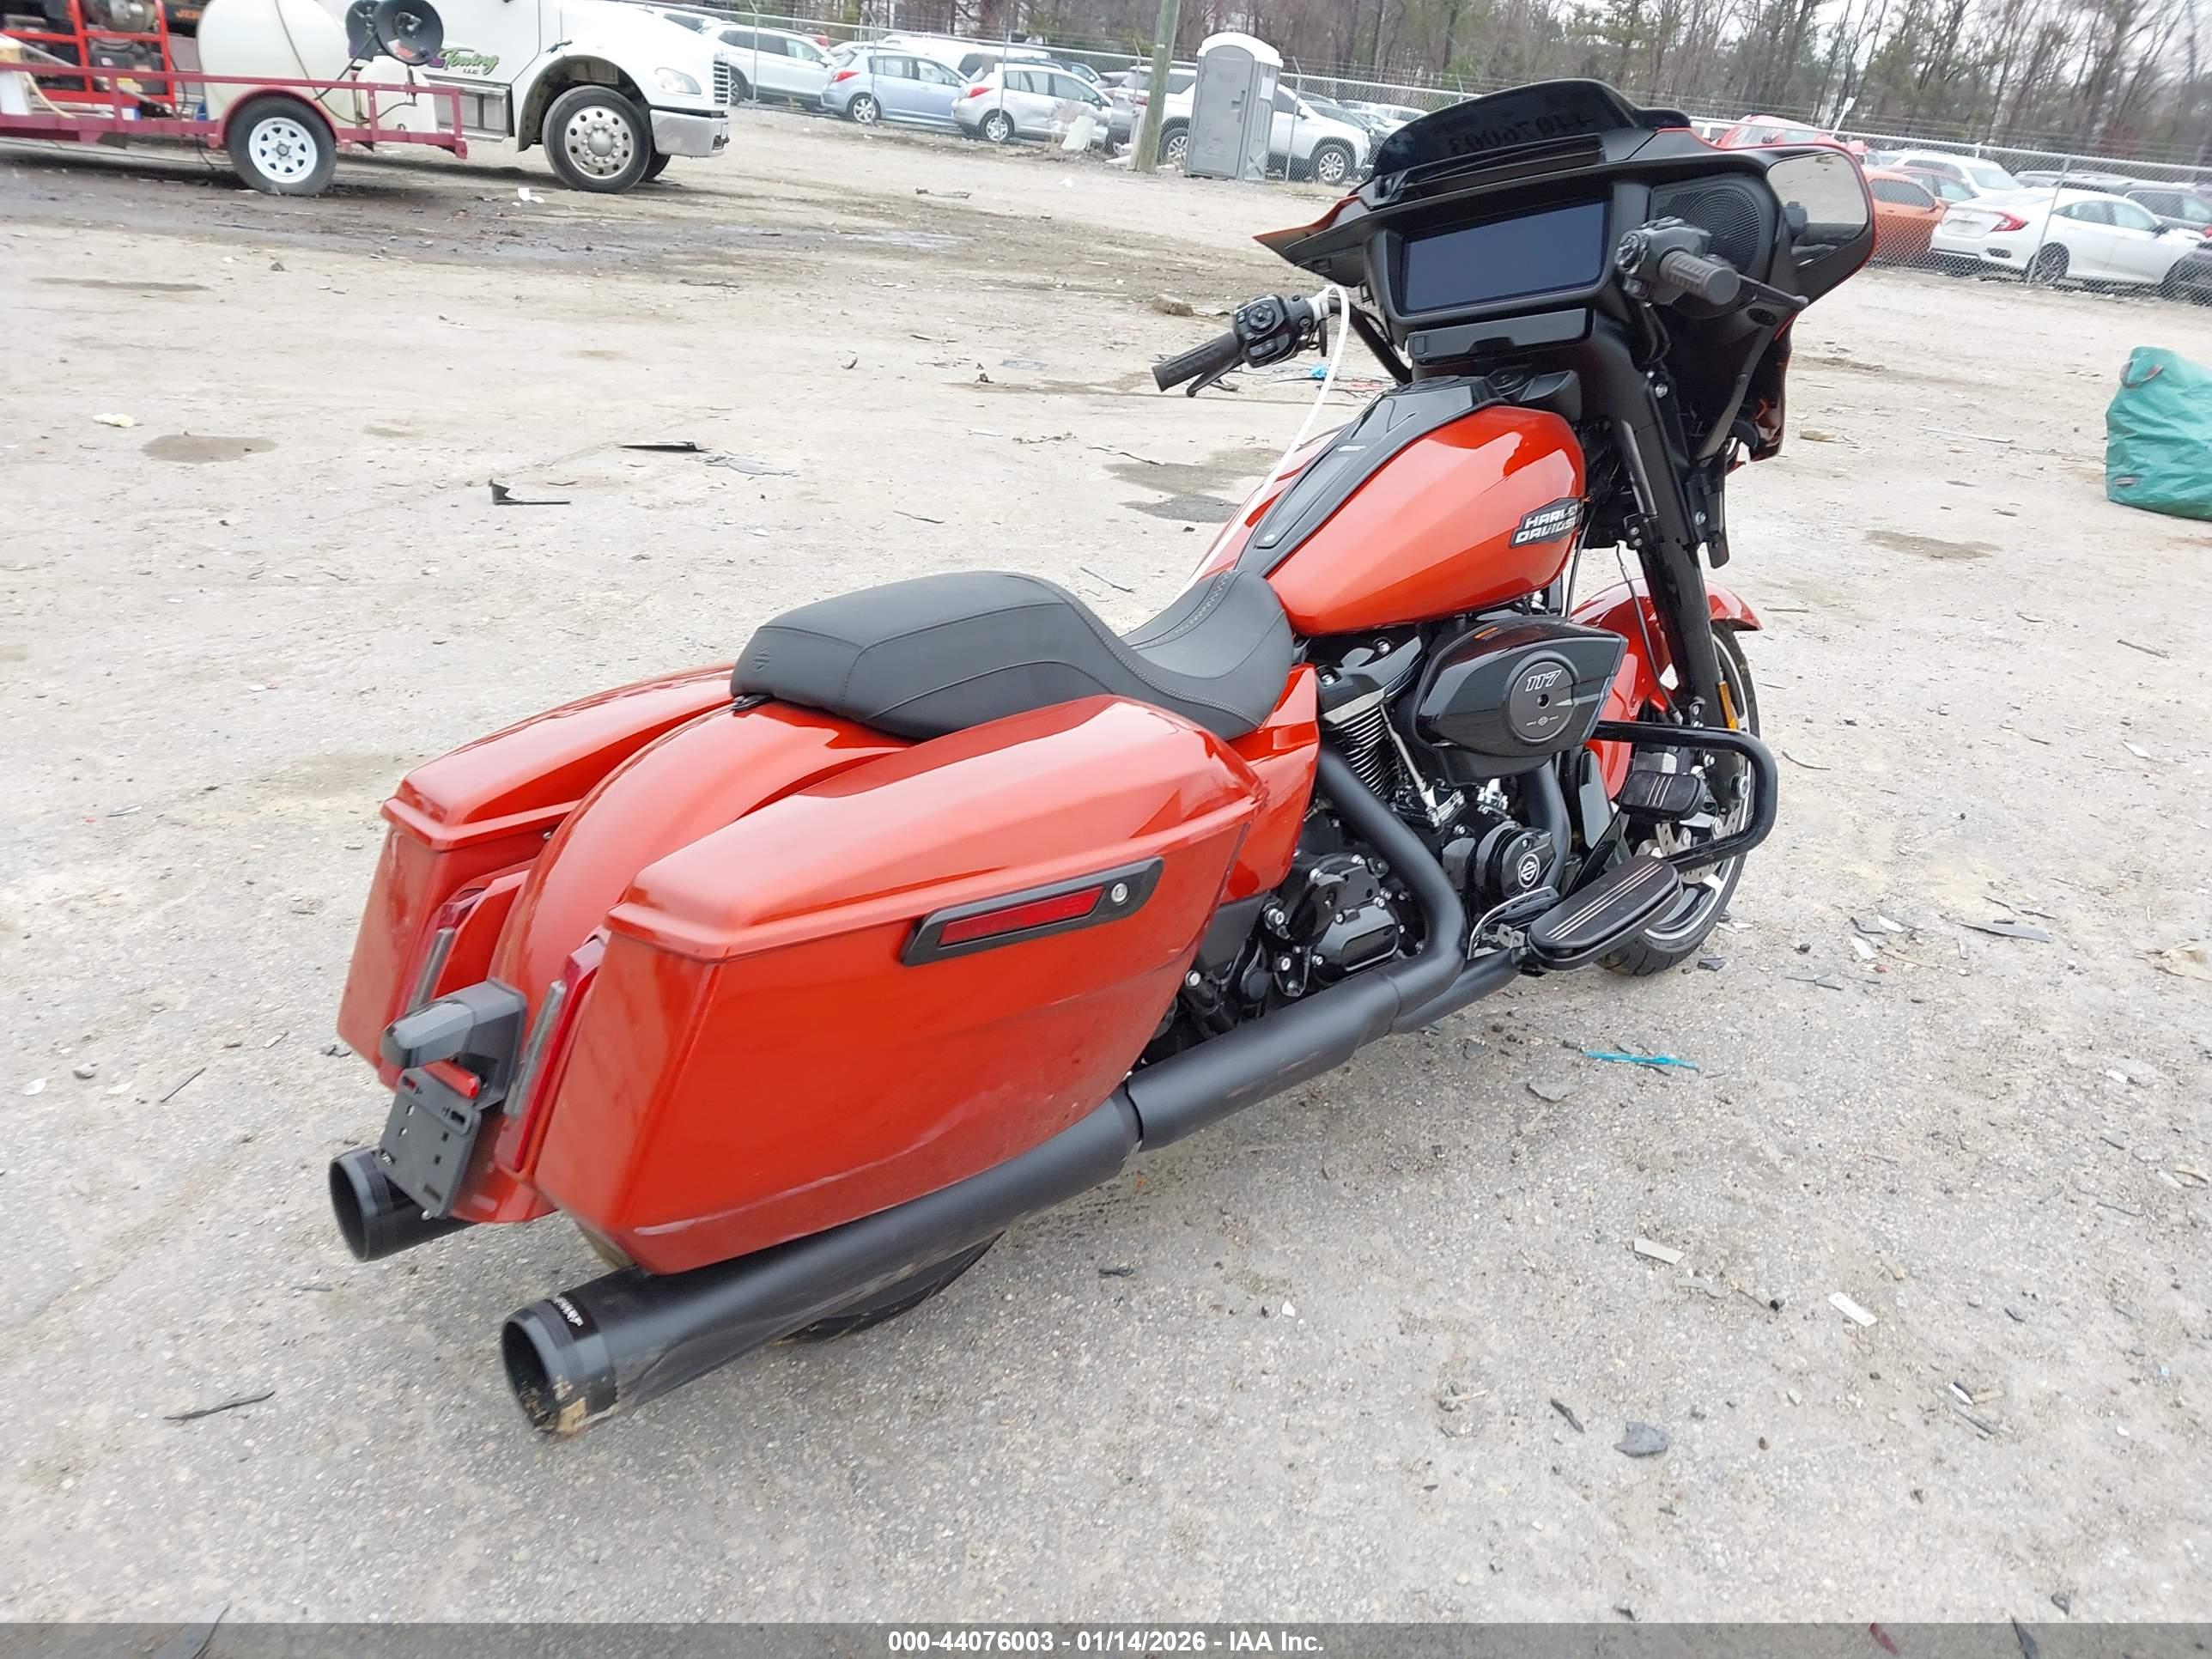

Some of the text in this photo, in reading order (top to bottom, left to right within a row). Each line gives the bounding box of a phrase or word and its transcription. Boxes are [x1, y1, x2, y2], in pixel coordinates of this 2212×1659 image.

[438, 47, 500, 76] Towing
[1514, 516, 1577, 544] DAVIDS
[1524, 503, 1580, 530] HARLE
[1525, 669, 1563, 692] 117
